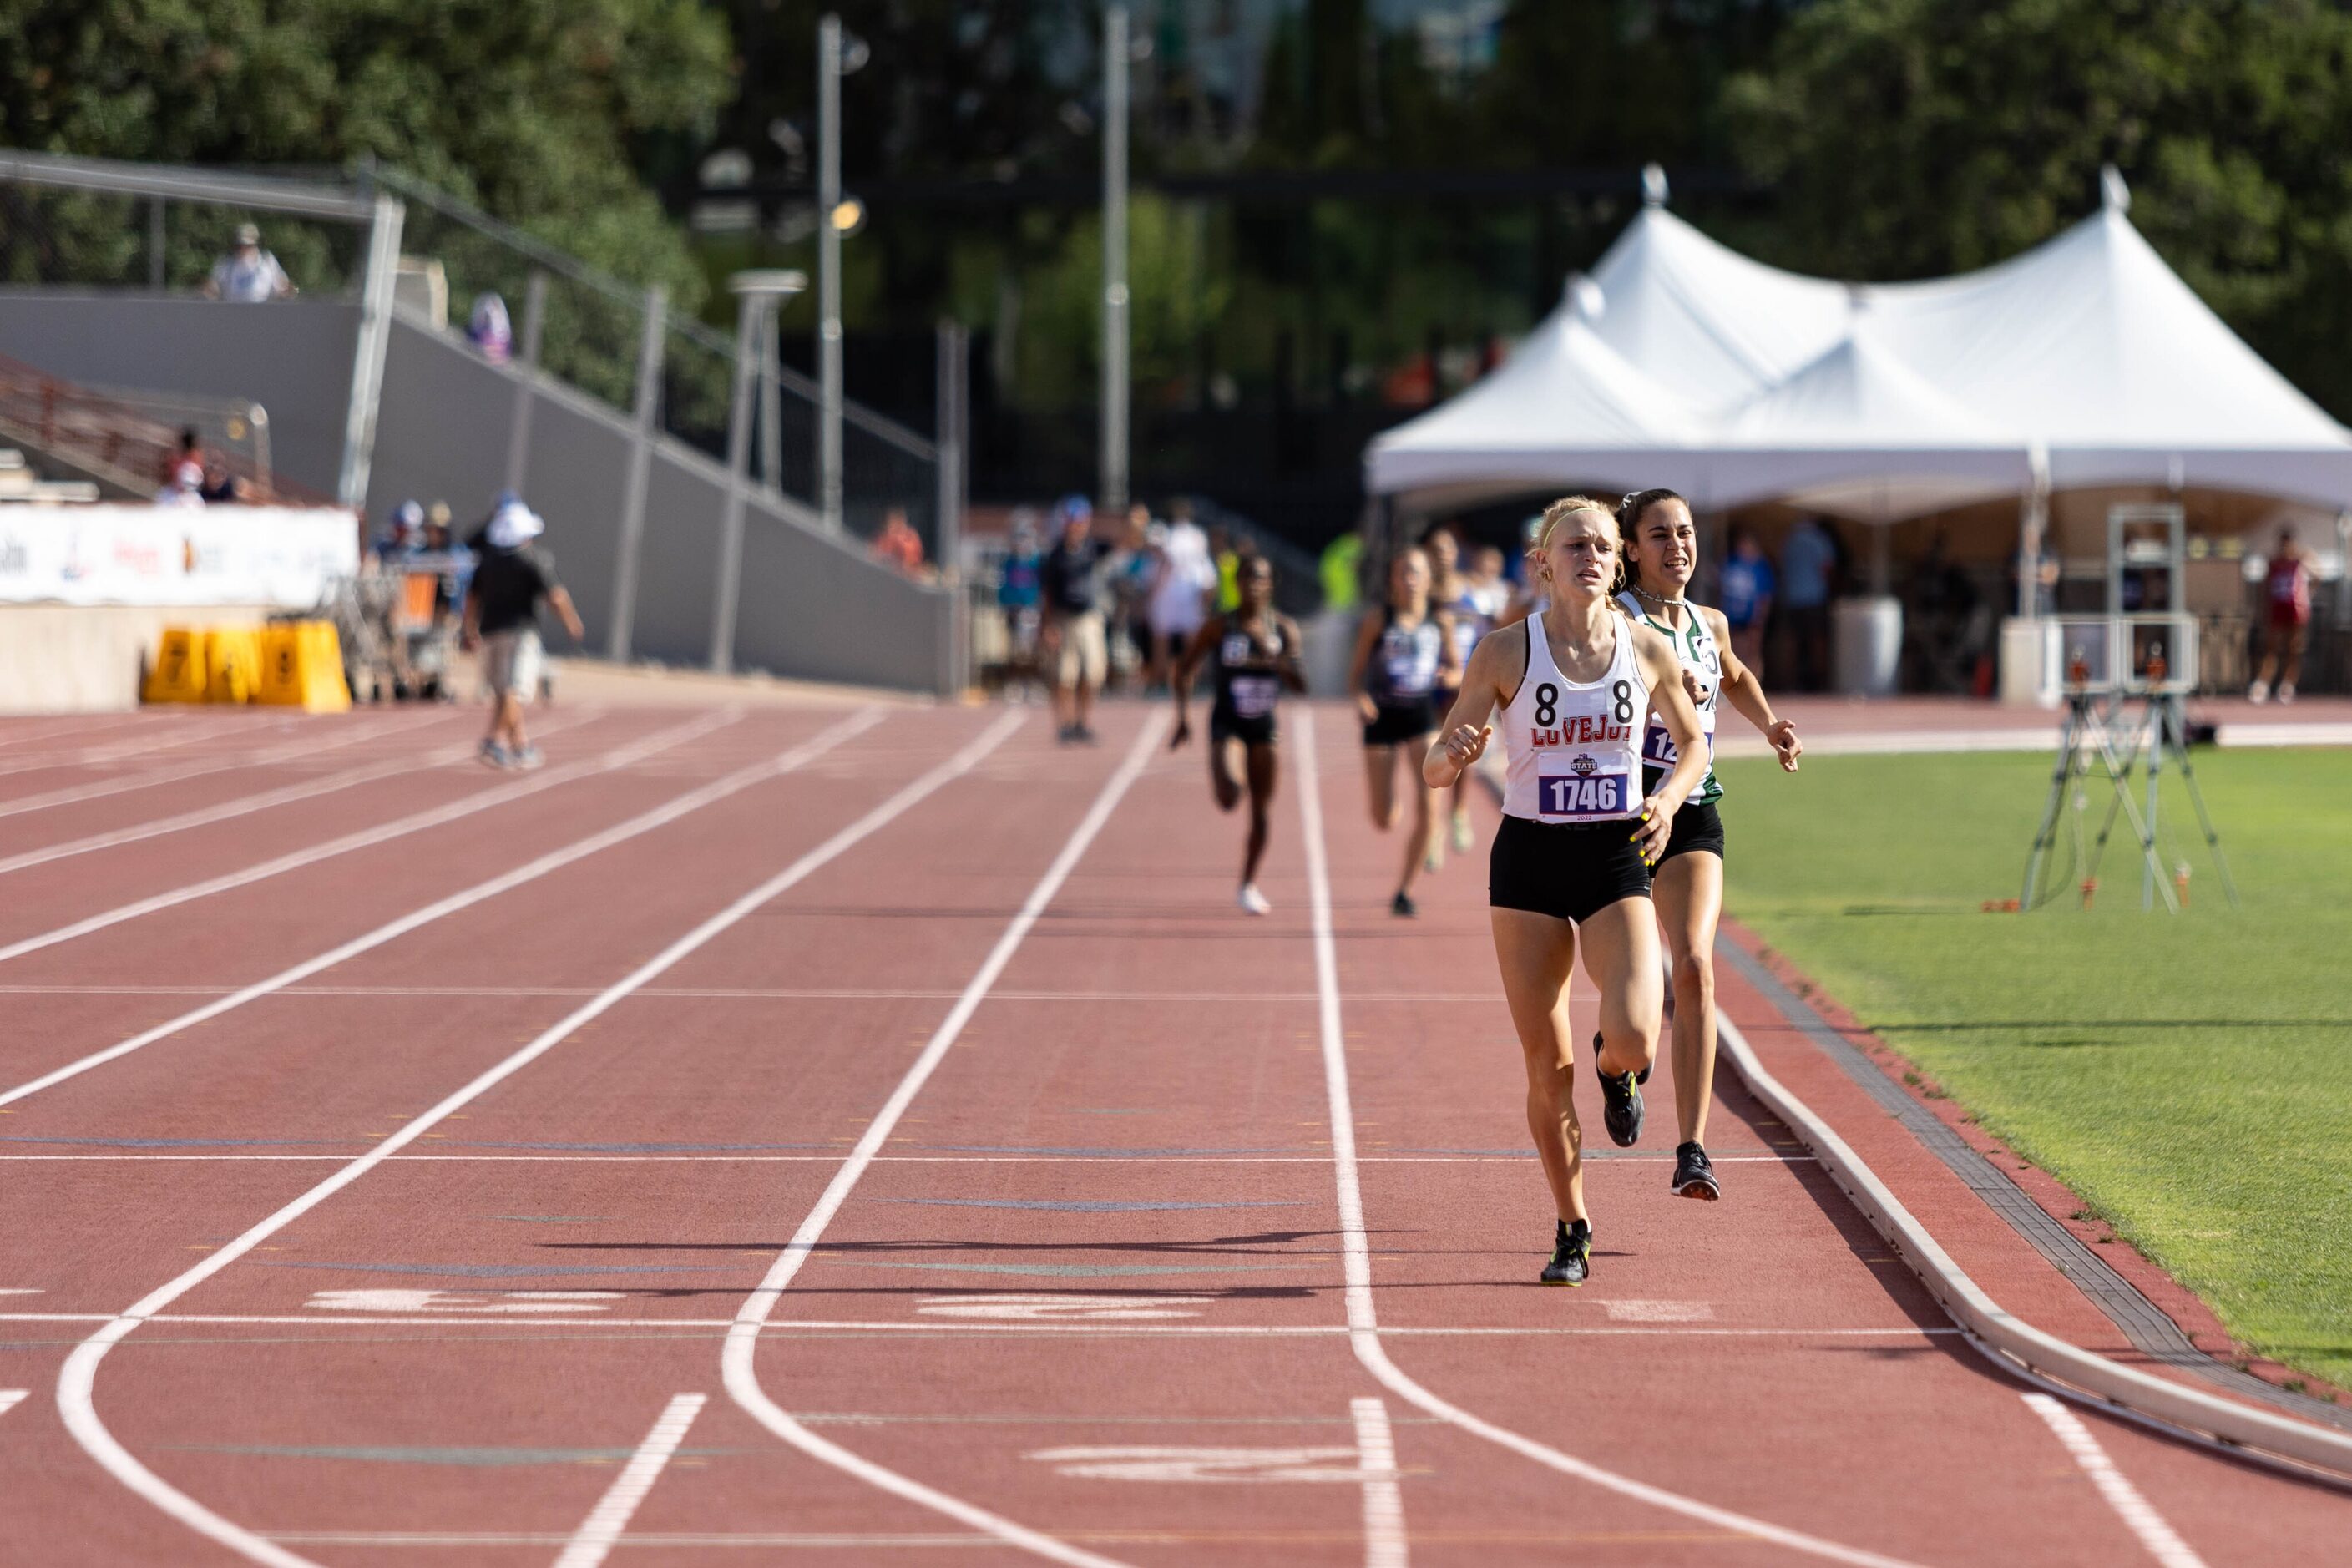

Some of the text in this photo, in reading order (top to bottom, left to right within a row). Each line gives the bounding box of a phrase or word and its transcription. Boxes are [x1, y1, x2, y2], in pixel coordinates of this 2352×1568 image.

[1535, 683, 1558, 727] 8
[1613, 680, 1634, 724] 8
[1550, 778, 1616, 812] 1746
